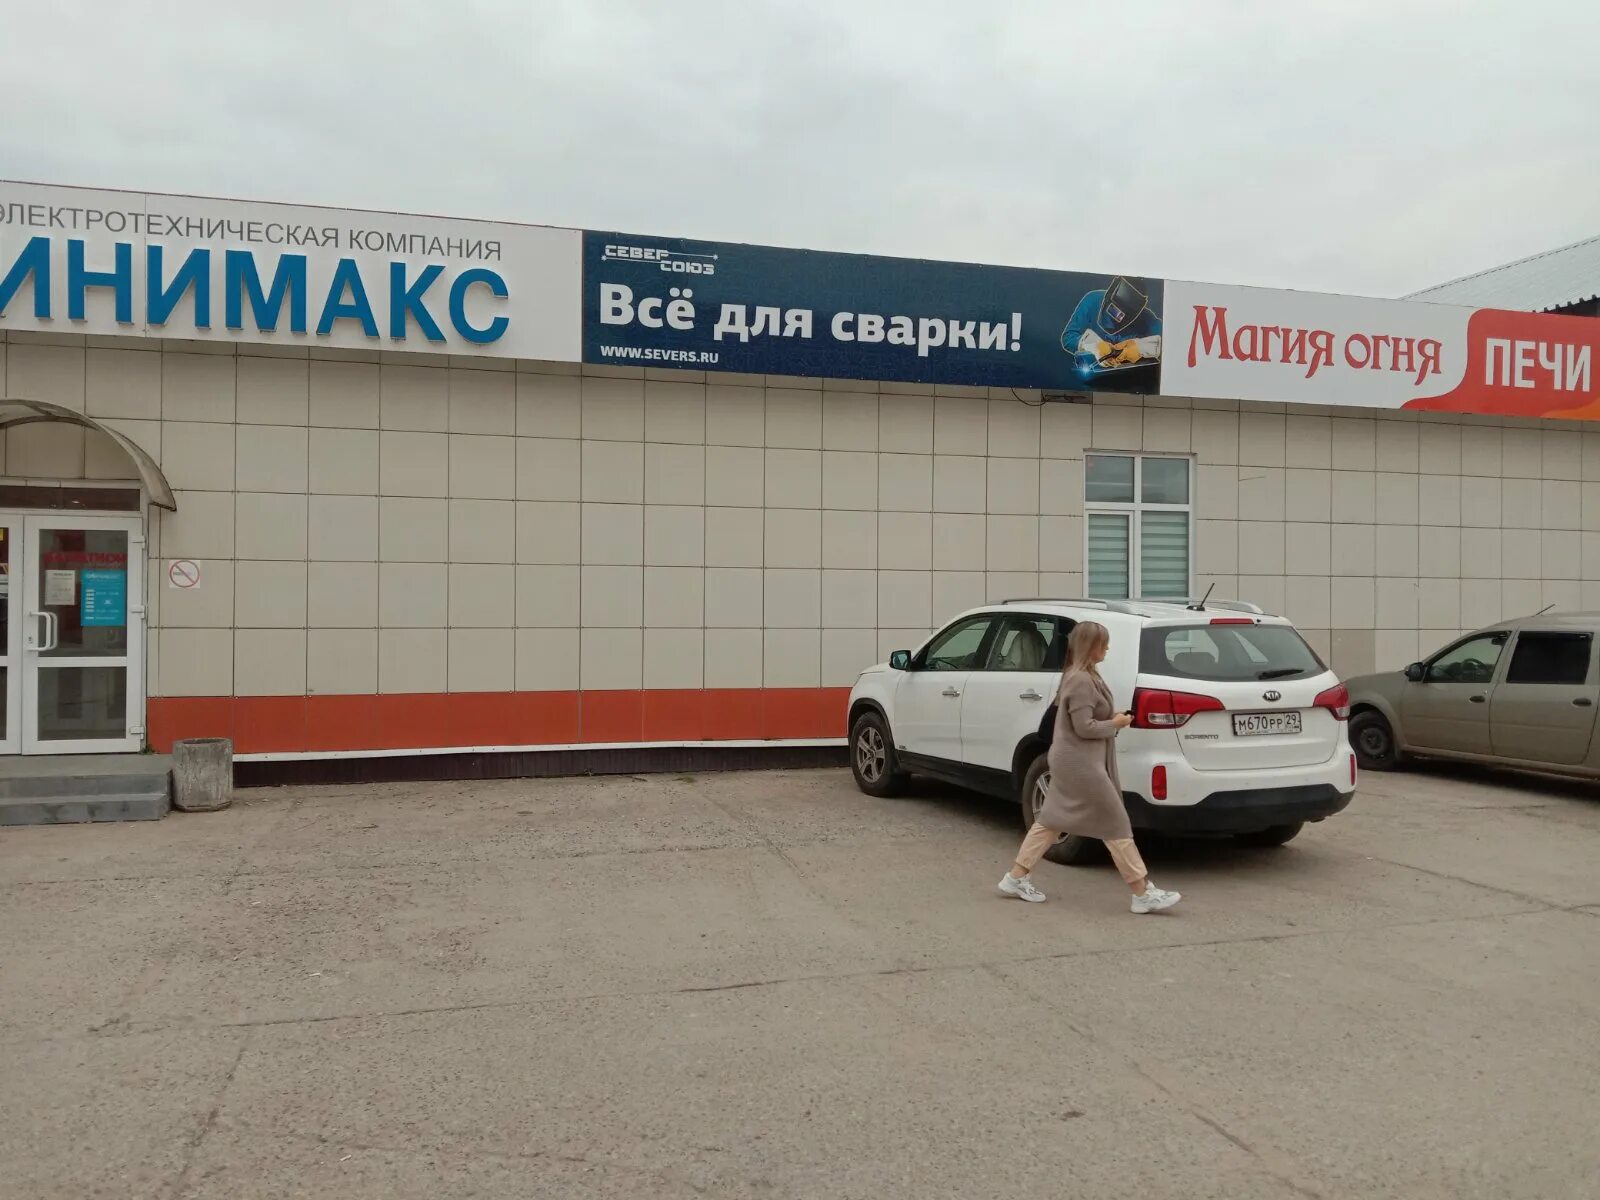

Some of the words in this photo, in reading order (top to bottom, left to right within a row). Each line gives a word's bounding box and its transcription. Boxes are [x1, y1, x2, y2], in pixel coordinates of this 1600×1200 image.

[0, 203, 339, 248] ЛЕКТРОТЕХНИЧЕСКАЯ
[349, 229, 501, 261] КОМПАНИЯ
[605, 245, 669, 261] СЕВЕР
[660, 260, 715, 275] СОЮЗ
[600, 282, 696, 330] Всё
[713, 303, 813, 343] для
[831, 311, 1022, 357] сварки!
[600, 345, 719, 364] WWW.SEVERS.RU
[1187, 305, 1335, 379] Магия
[1344, 333, 1443, 386] огня
[1484, 337, 1591, 392] ПЕЧИ
[1265, 691, 1281, 700] KIA
